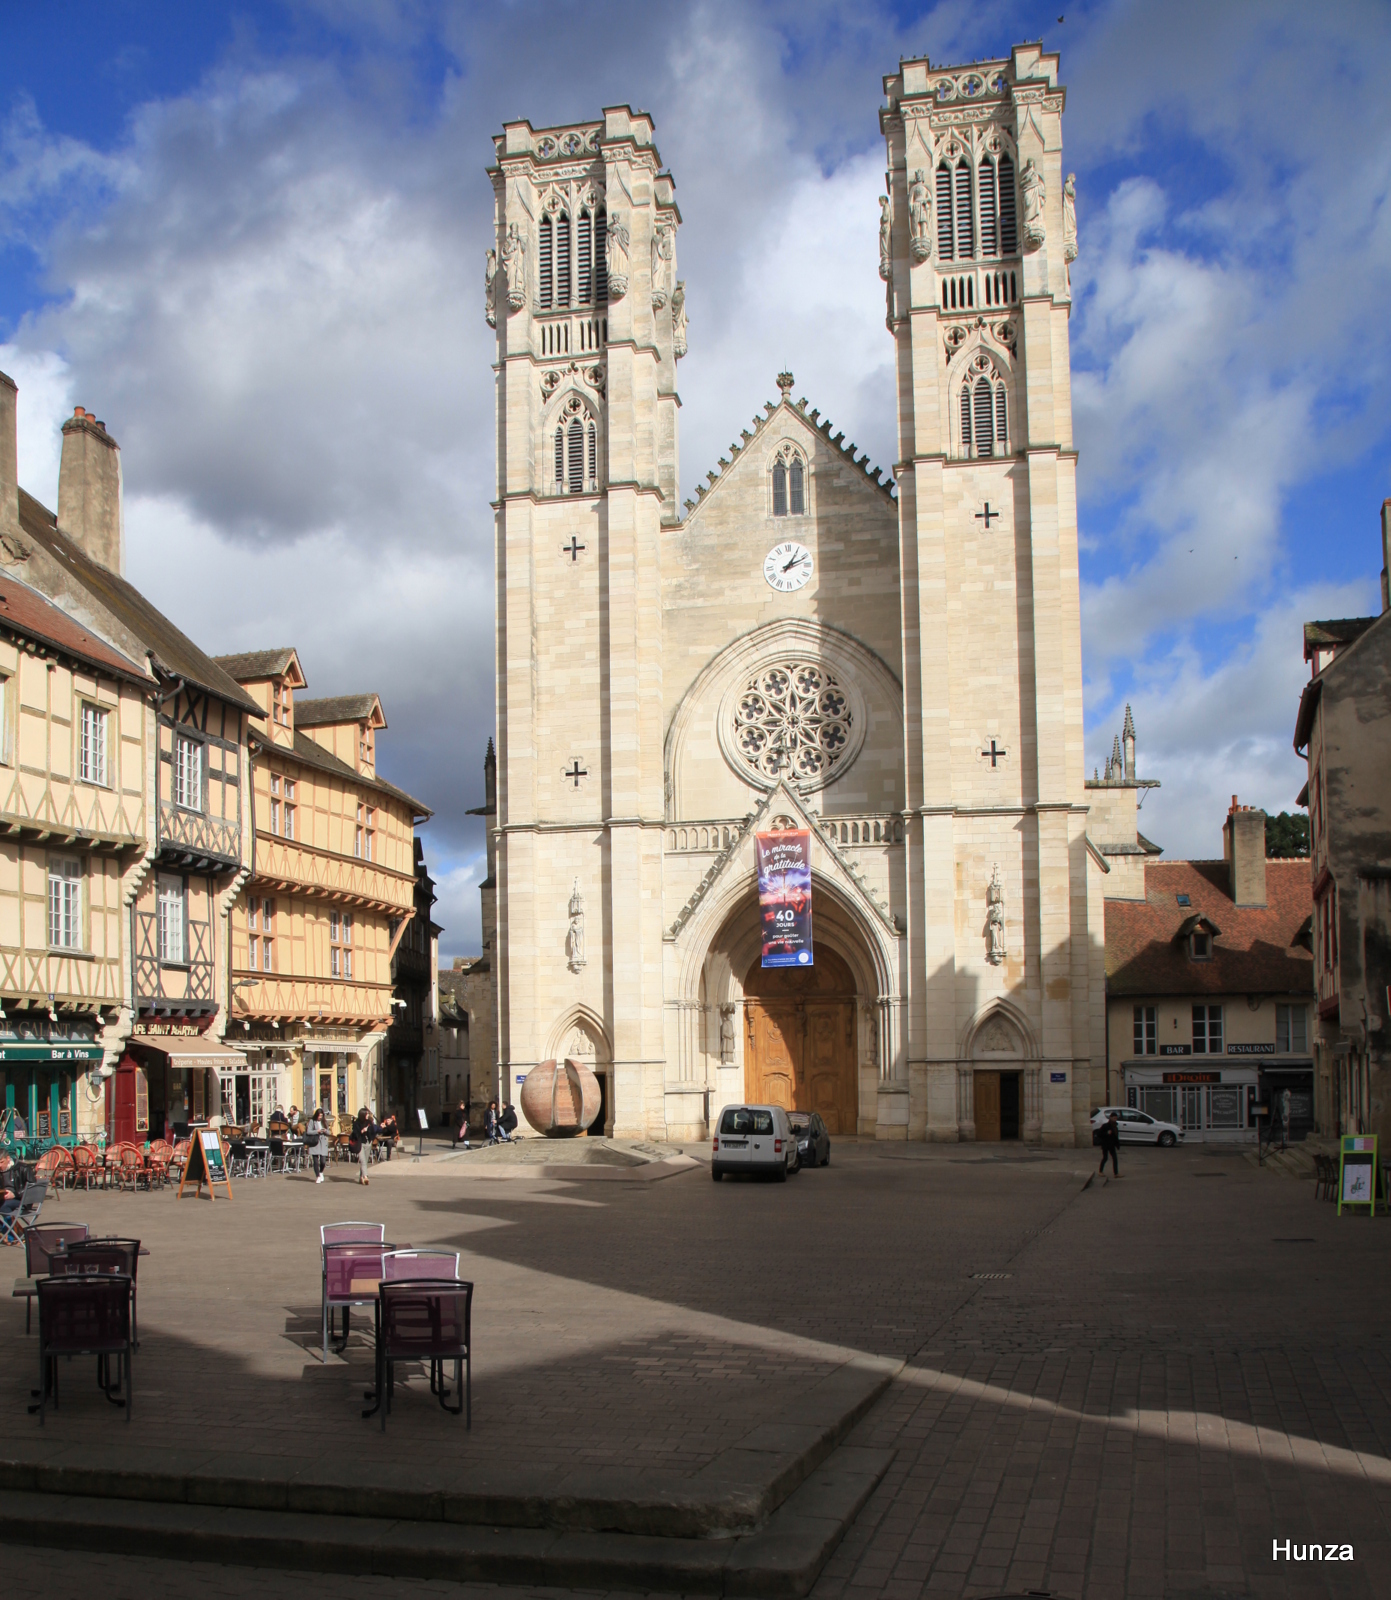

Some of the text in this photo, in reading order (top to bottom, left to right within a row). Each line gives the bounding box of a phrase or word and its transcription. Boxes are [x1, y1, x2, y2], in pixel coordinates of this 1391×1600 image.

[761, 843, 803, 858] Le miracle
[763, 859, 806, 879] gratitude
[776, 910, 794, 921] 40
[18, 1021, 71, 1038] GALANT
[147, 1024, 171, 1035] SAINT
[171, 1024, 199, 1036] MARTIN
[51, 1050, 89, 1059] Bar à Vins
[1166, 1046, 1184, 1054] BAR
[1228, 1045, 1274, 1053] RESTAURANT
